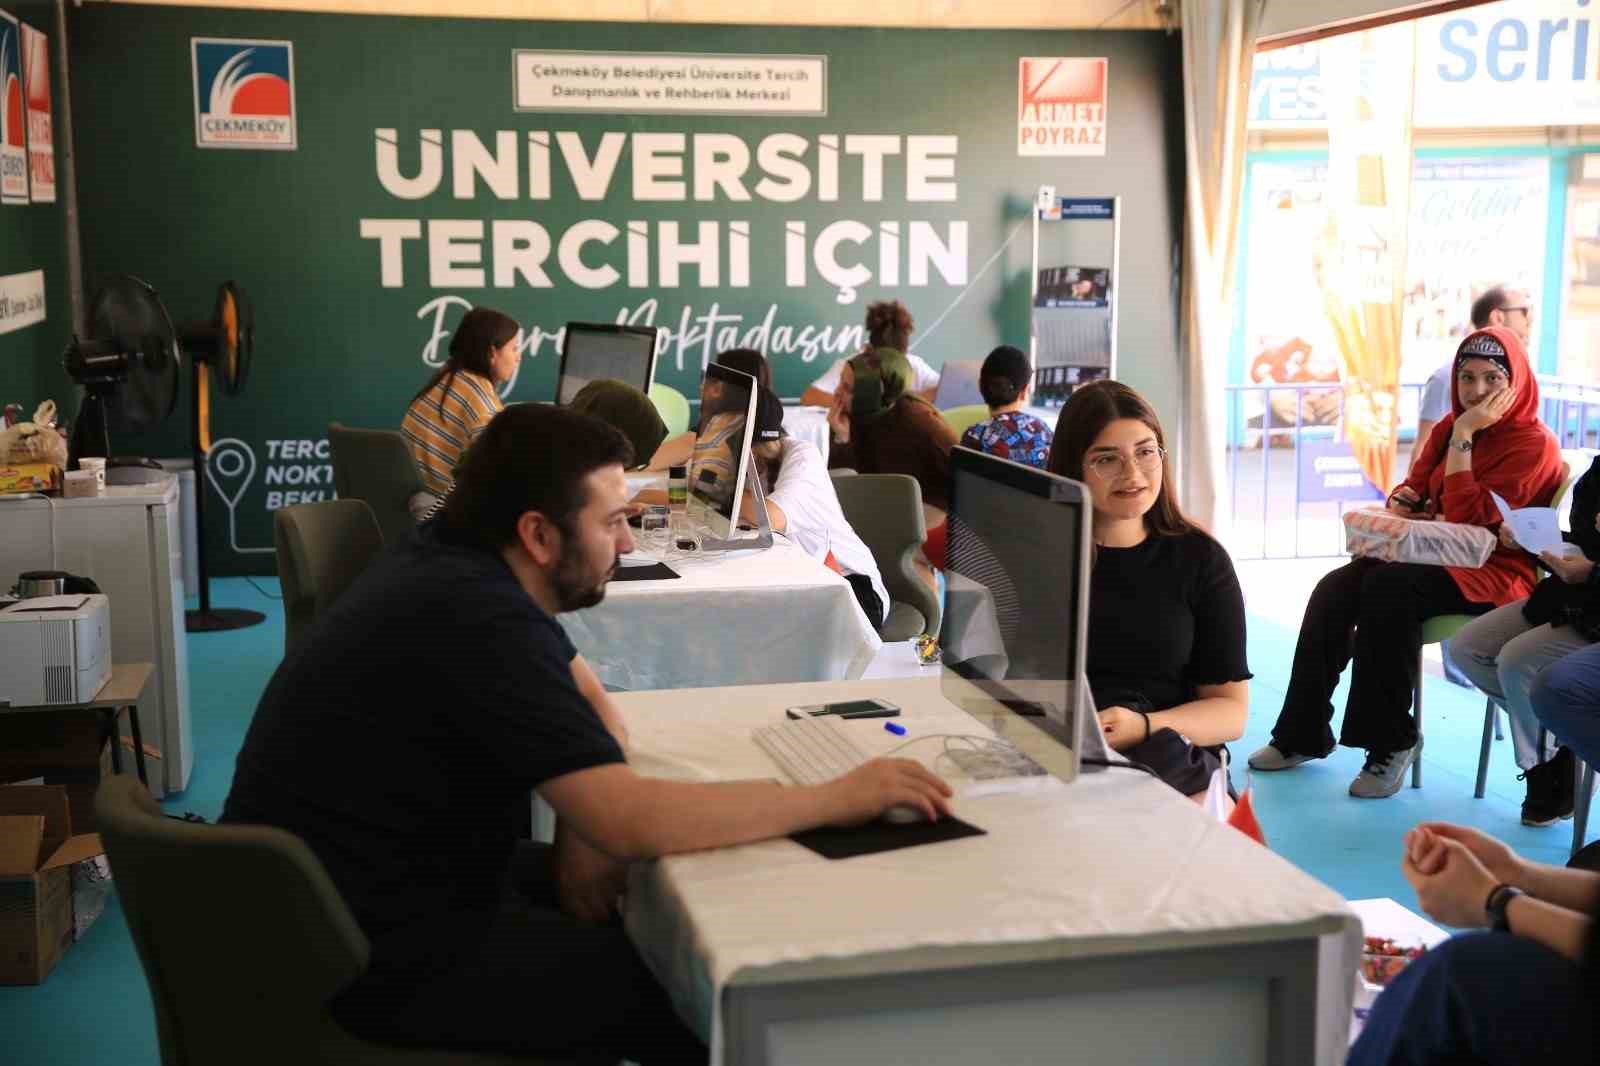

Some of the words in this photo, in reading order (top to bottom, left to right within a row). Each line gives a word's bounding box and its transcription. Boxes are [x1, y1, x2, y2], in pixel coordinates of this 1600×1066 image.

[531, 63, 608, 80] Çekmeköy
[613, 66, 687, 81] Belediyesi
[690, 64, 761, 80] Üniversite
[766, 68, 809, 80] Tercih
[551, 84, 640, 100] Danışmanlık
[645, 89, 661, 98] ve
[664, 87, 731, 99] Rehberlik
[735, 88, 791, 101] Merkezi
[1021, 103, 1104, 122] AHMET
[1021, 126, 1102, 146] POYRAZ
